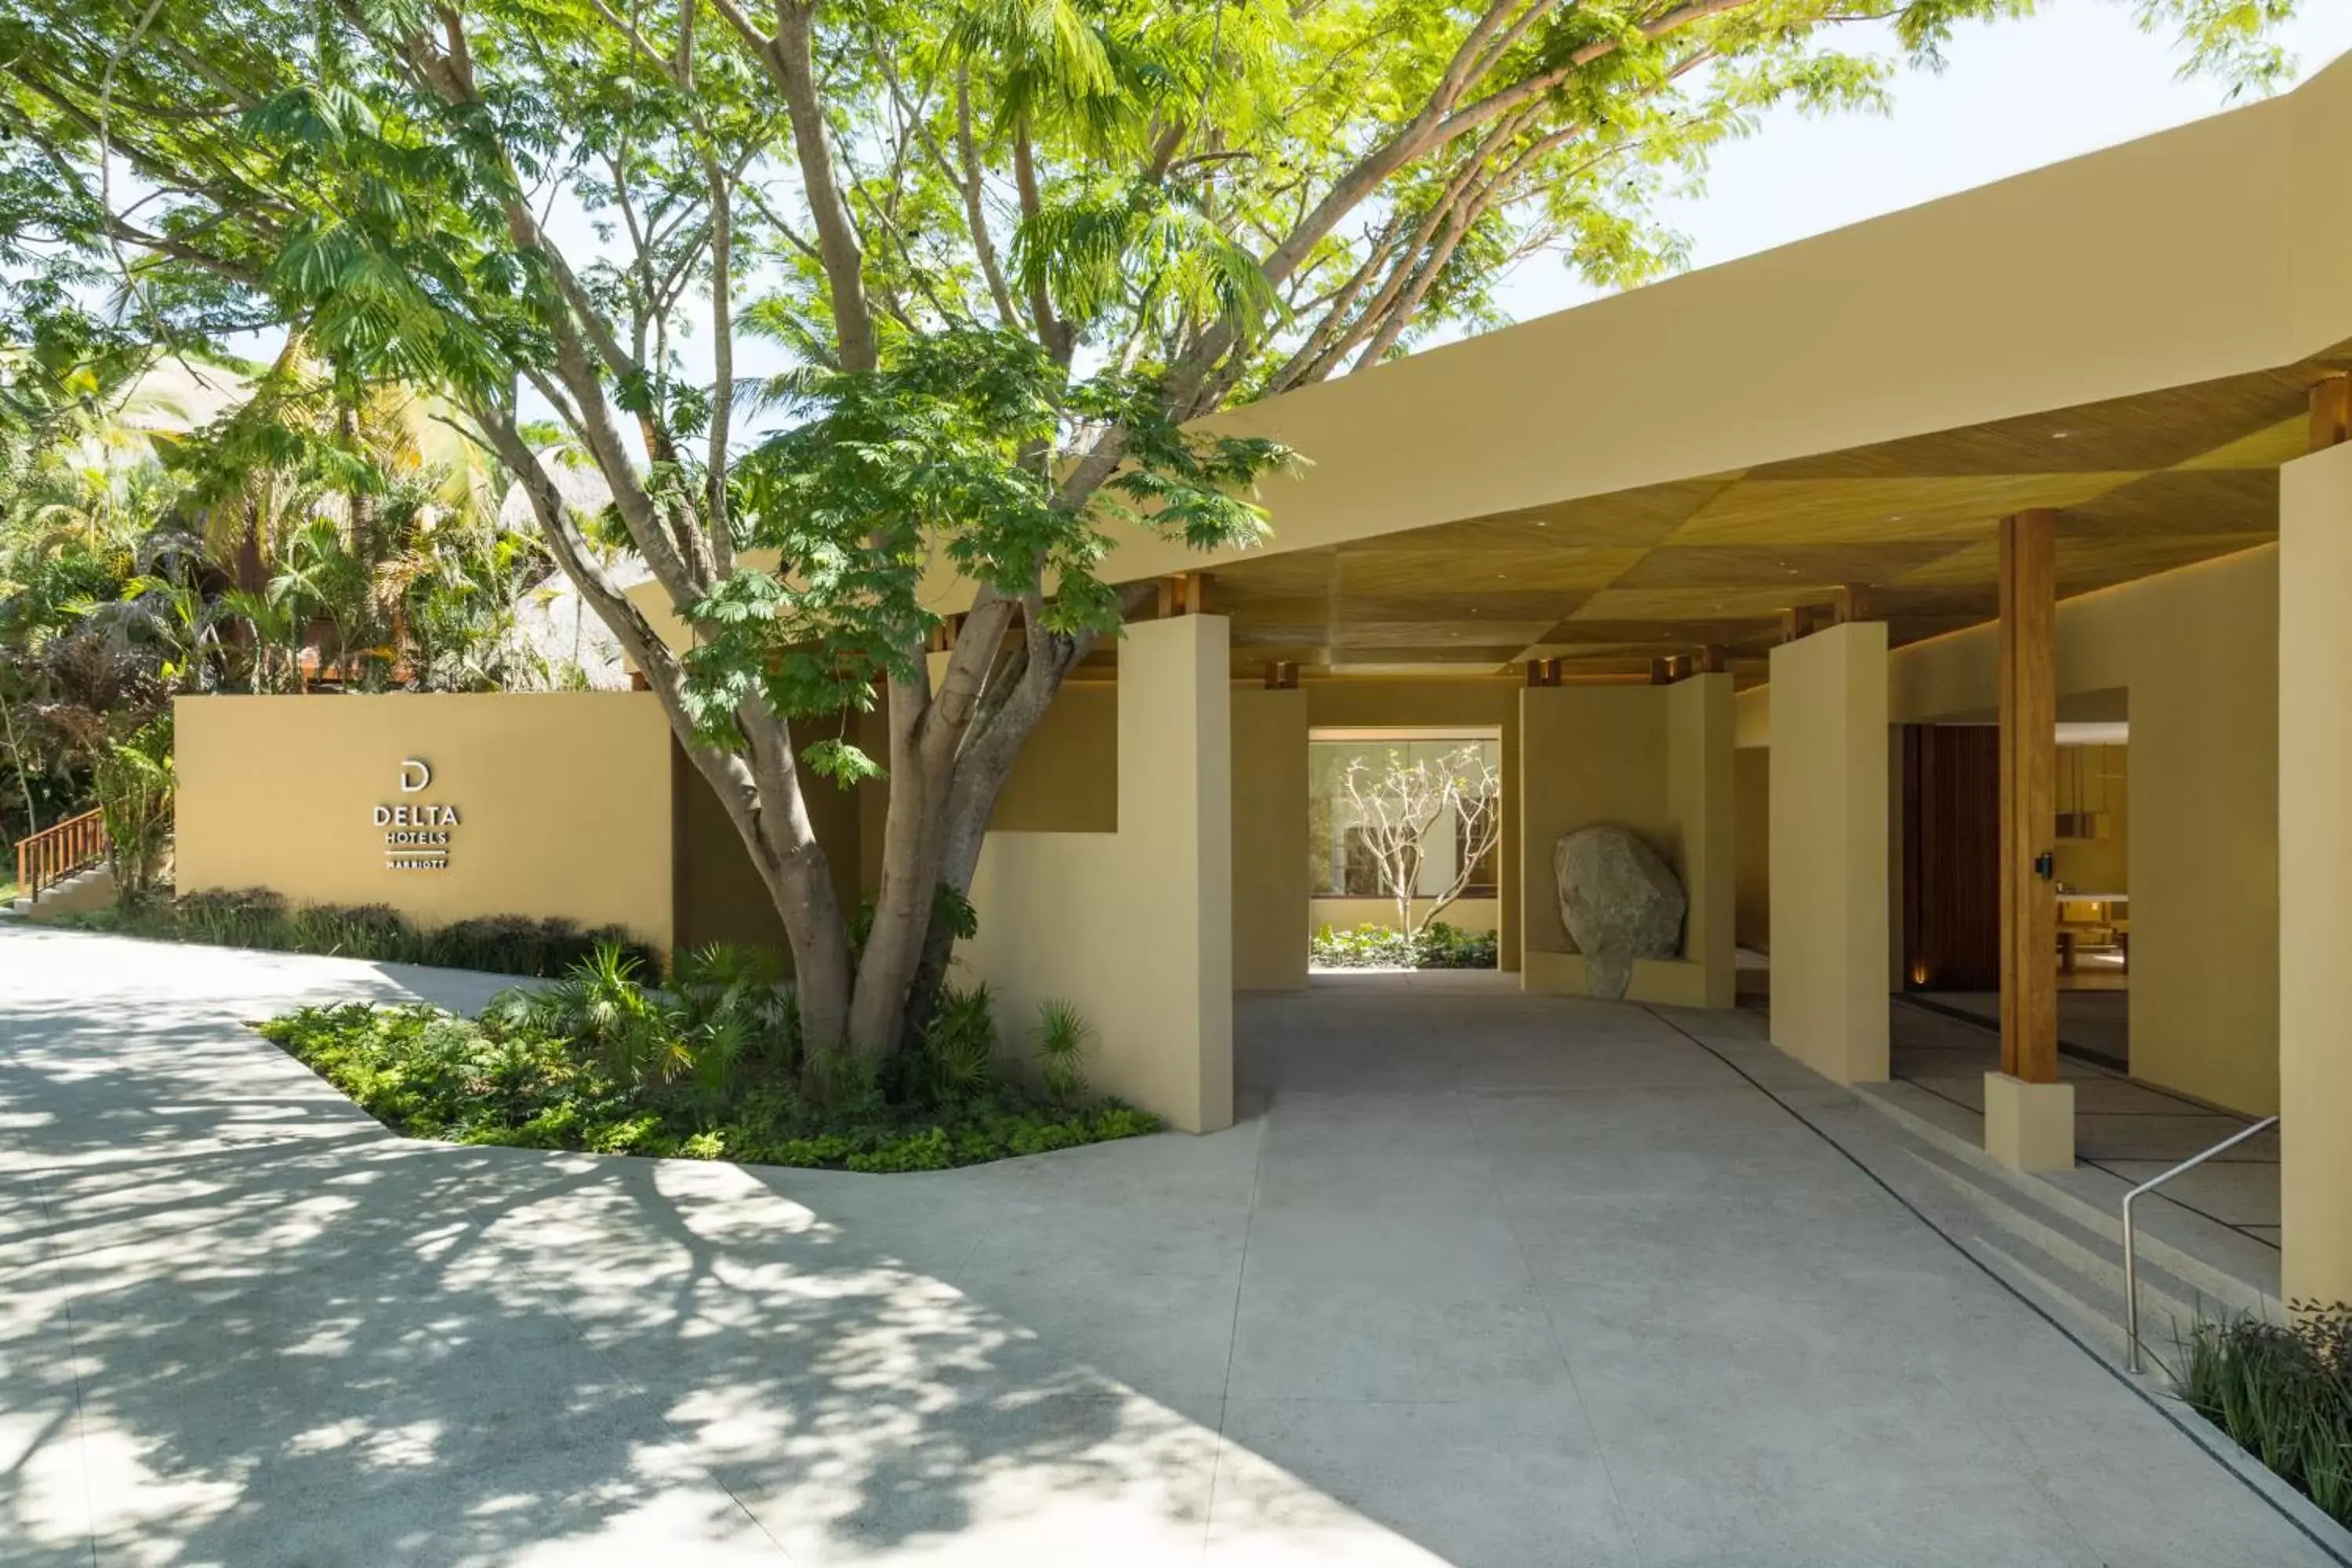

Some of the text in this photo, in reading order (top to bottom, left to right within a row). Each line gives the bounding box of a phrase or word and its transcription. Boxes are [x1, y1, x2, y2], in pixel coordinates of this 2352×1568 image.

[373, 806, 459, 826] DELTA
[385, 832, 448, 844] HOTELS
[386, 860, 446, 869] MARRIOTT
